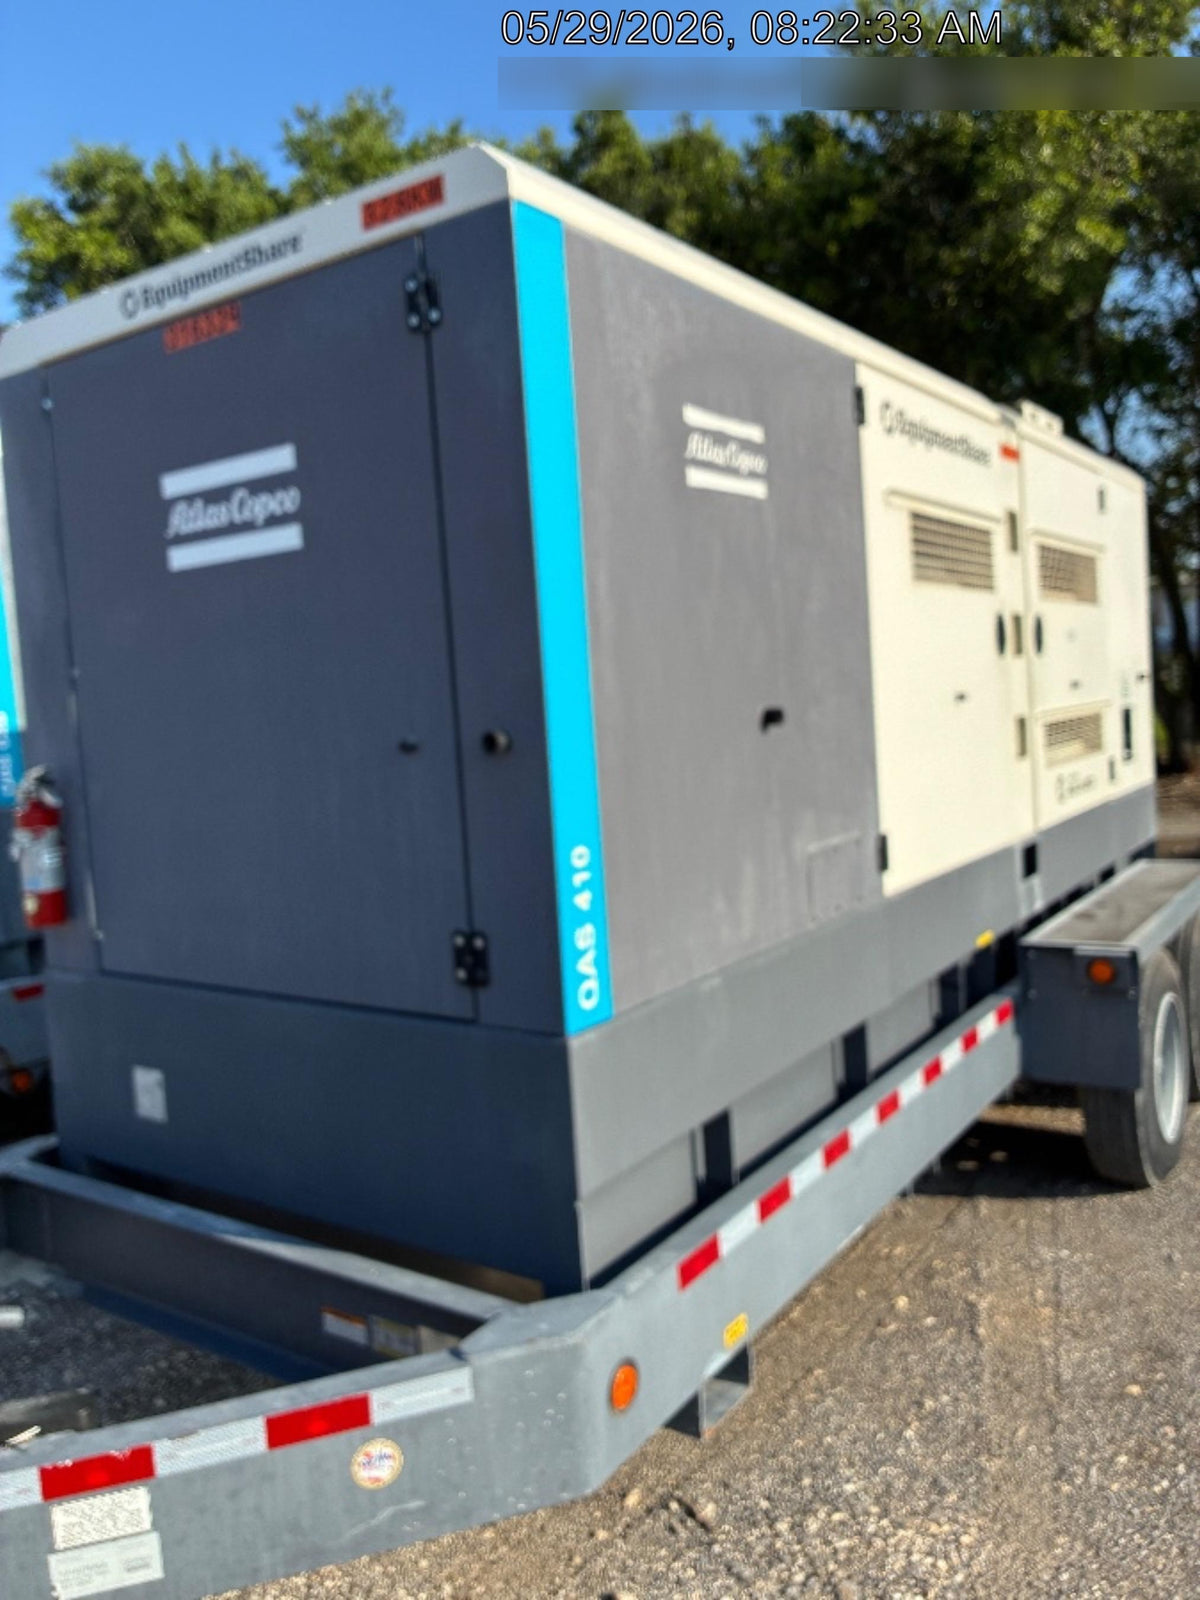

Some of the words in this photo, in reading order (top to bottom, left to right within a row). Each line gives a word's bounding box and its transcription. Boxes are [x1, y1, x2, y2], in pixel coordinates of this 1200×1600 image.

[142, 234, 302, 309] EquipmentShare
[164, 497, 231, 540] Atlas
[229, 486, 302, 527] Copco
[570, 844, 593, 912] 410
[574, 922, 600, 1011] QAS
